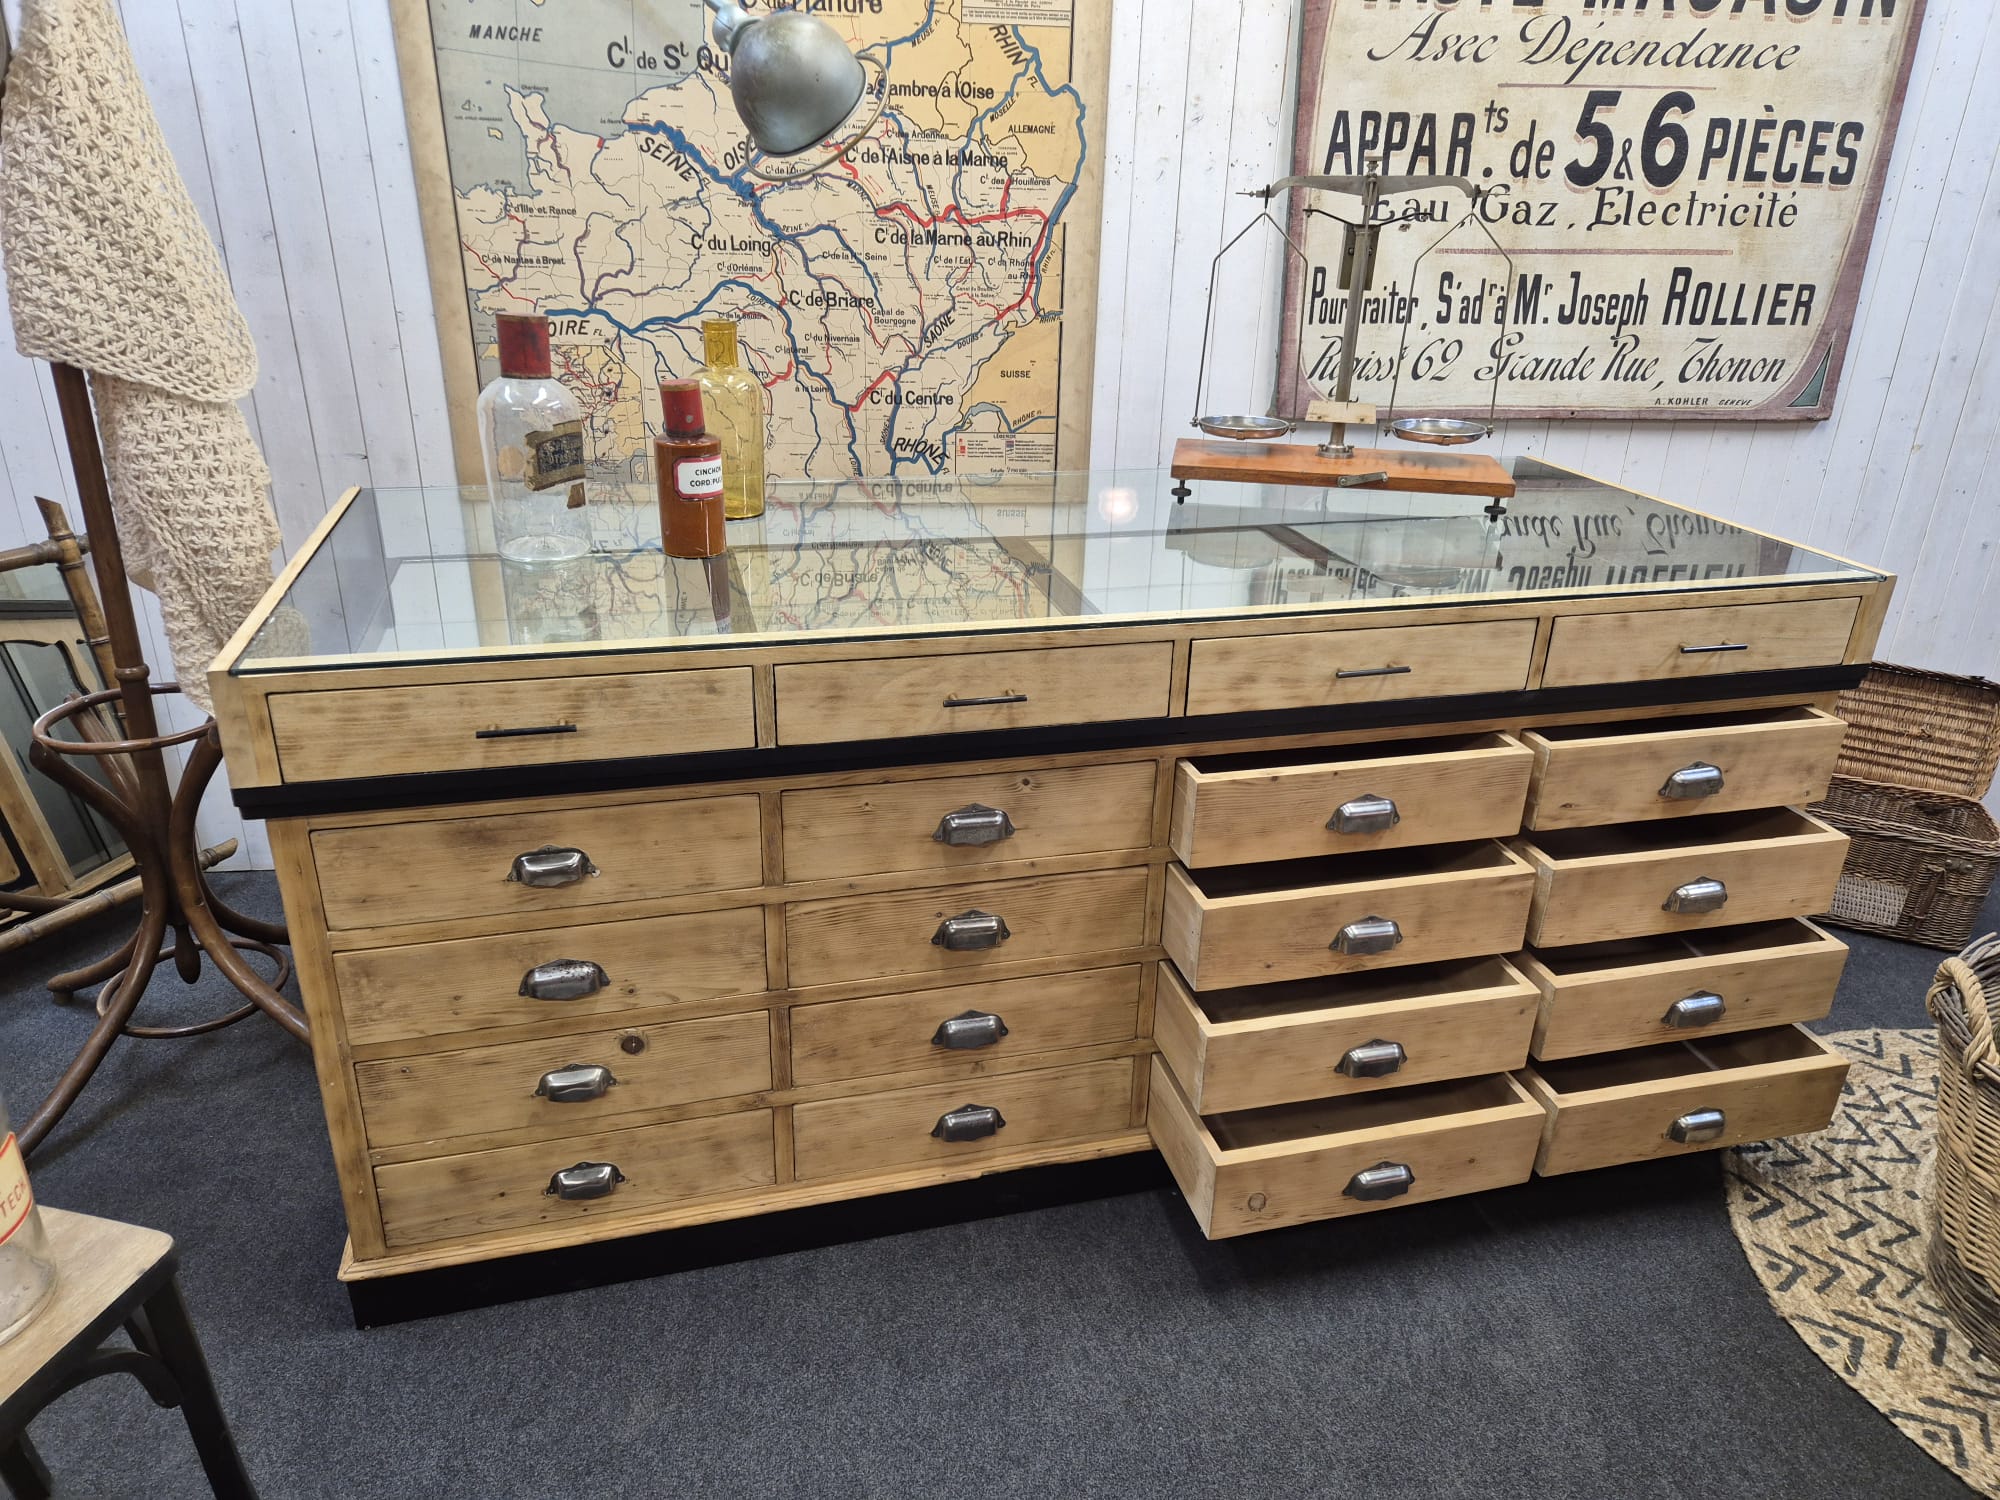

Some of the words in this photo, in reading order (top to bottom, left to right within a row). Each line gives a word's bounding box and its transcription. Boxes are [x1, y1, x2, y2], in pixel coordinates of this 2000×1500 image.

[469, 24, 543, 42] MANCHE
[989, 23, 1028, 66] RHIN
[1519, 14, 1801, 85] Dépendance
[636, 51, 657, 70] de
[663, 41, 689, 71] St
[941, 81, 951, 98] à
[911, 129, 949, 140] Ardennes
[1008, 125, 1056, 135] ALLEMAGNE
[1509, 119, 1556, 179] de
[1697, 105, 1865, 186] PIÈCES
[640, 136, 702, 182] SEINE
[861, 147, 879, 165] de
[933, 150, 943, 166] à
[946, 149, 958, 166] la
[961, 150, 1008, 167] Marne
[1586, 186, 1798, 231] Electricité
[707, 234, 727, 251] du
[731, 235, 771, 257] Loing
[890, 228, 905, 245] de
[910, 228, 925, 245] la
[926, 229, 972, 246] Marne
[976, 233, 995, 247] au
[998, 231, 1032, 248] Rhin
[864, 251, 888, 261] Seine
[806, 291, 824, 307] de
[826, 291, 875, 308] Briare
[1308, 266, 1348, 325] Pour
[1361, 280, 1427, 330] raiter,
[1558, 271, 1649, 338] Joseph
[1661, 266, 1817, 326] ROLLIER
[871, 307, 893, 316] Canal
[895, 307, 905, 316] de
[873, 316, 917, 326] Bourgogne
[549, 319, 591, 338] OIRE
[1411, 337, 1464, 382] 62
[1678, 335, 1787, 384] Thonon
[1000, 370, 1032, 379] SUISSE
[885, 390, 903, 406] du
[906, 390, 954, 406] Centre
